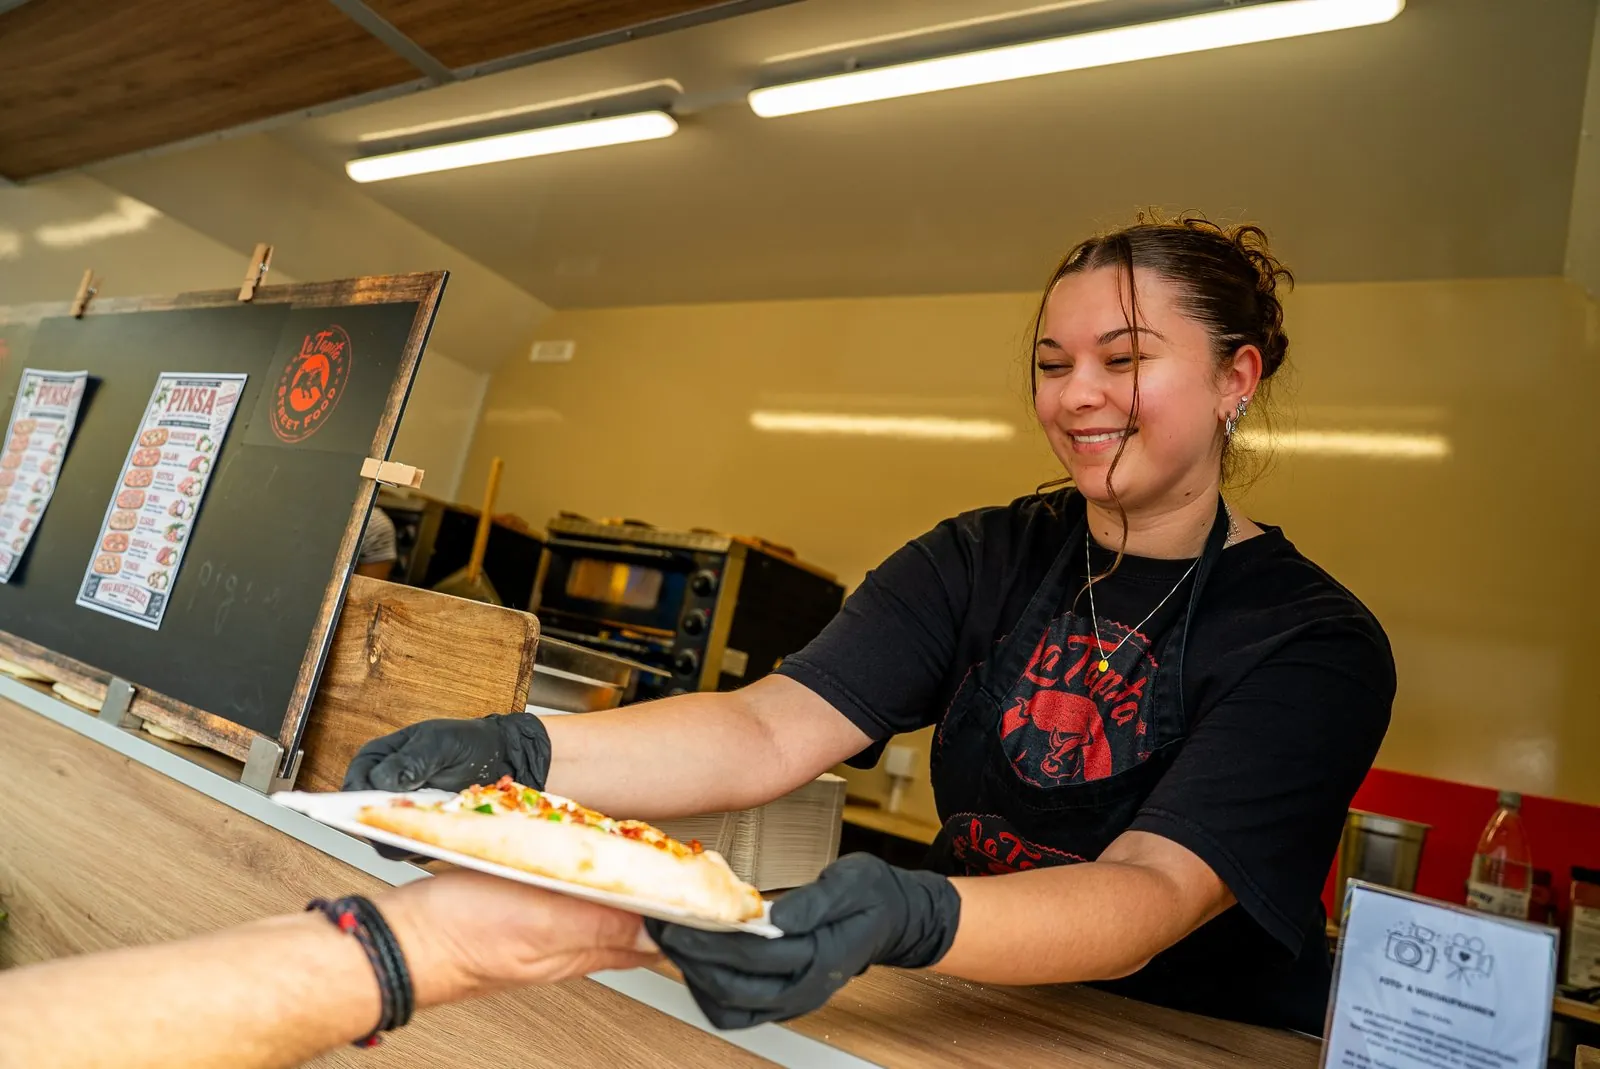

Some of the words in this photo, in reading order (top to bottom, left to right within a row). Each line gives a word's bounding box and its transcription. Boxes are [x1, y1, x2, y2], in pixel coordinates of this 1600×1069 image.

[165, 387, 217, 416] PINSA
[277, 385, 301, 431] STREET
[303, 387, 336, 429] FOOD
[1020, 626, 1063, 688] La
[969, 818, 1004, 864] La
